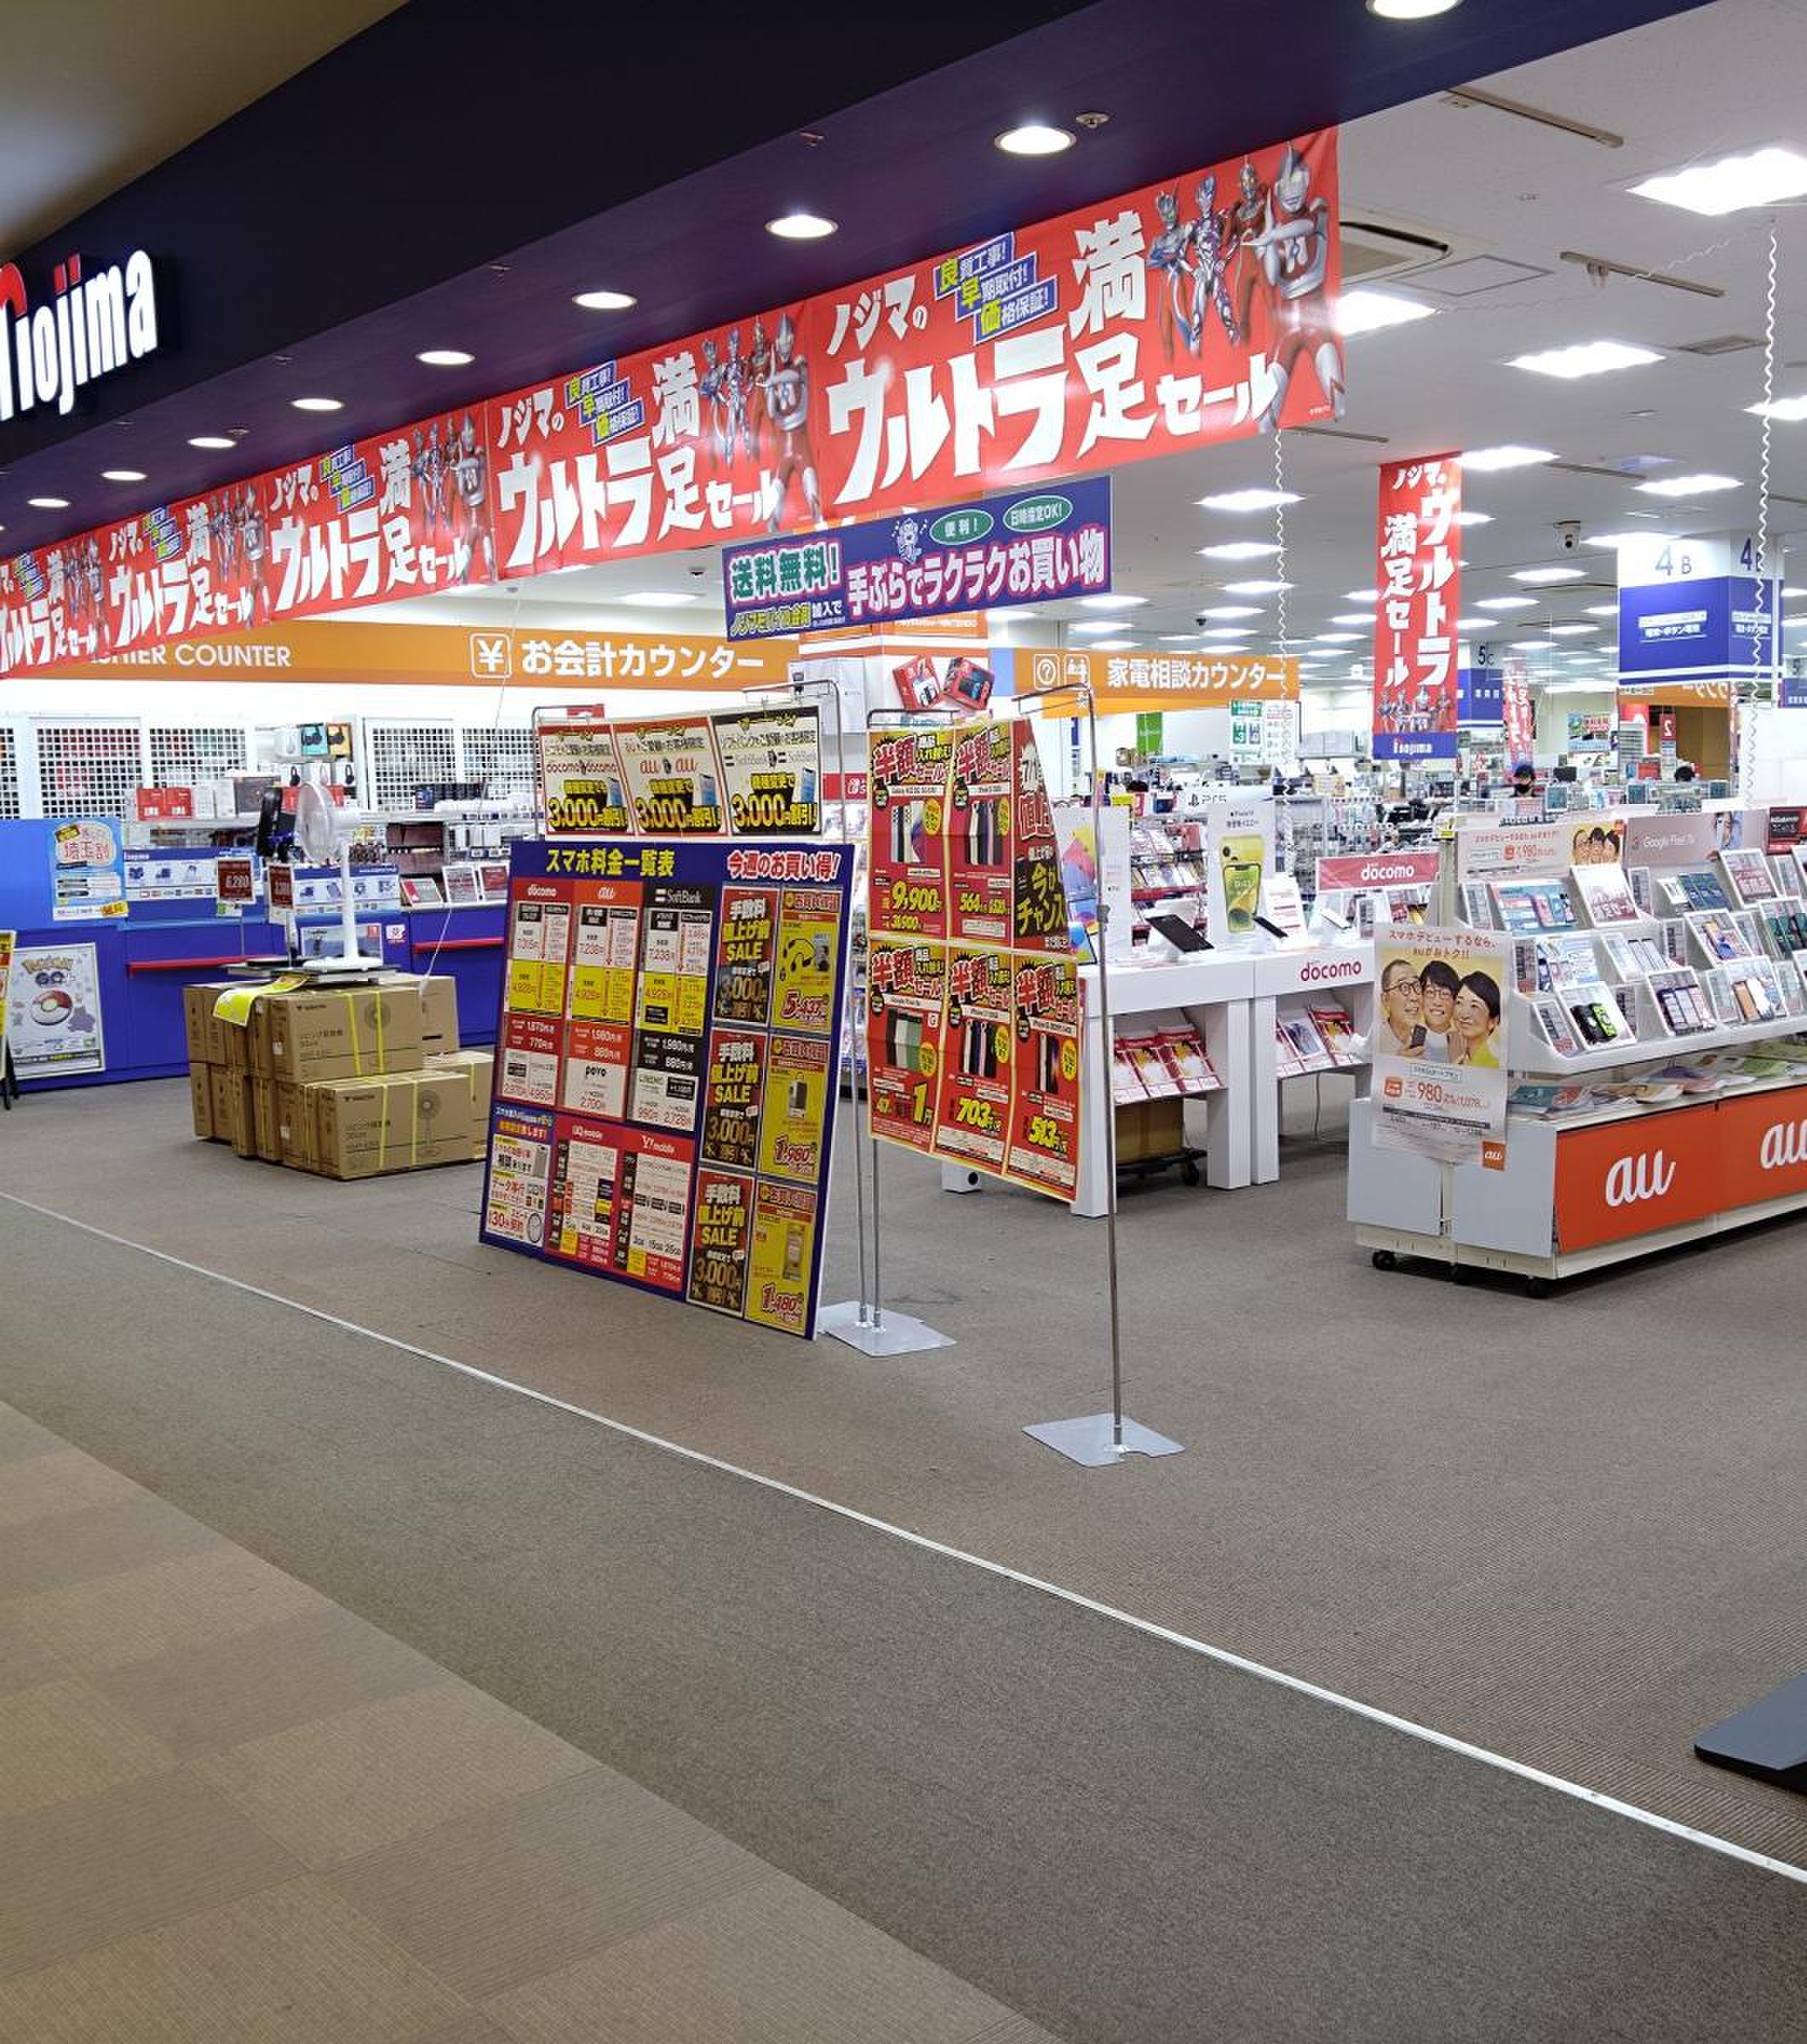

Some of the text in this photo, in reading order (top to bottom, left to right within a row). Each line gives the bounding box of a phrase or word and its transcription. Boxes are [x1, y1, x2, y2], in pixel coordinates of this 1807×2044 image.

[827, 274, 927, 355] ノジマの
[497, 388, 565, 449] ノジマの
[270, 464, 319, 512] ノジマの
[848, 529, 1105, 617] 手ぶらでラクラクお買い物
[1417, 488, 1461, 686] ウルトラ
[175, 644, 291, 667] COUNTER
[521, 640, 763, 678] お会計カウンター
[1107, 657, 1284, 690] 家電相談カウンター
[546, 848, 675, 877] スマホ料金一覧表
[728, 850, 841, 881] 今週のお買い得!
[1361, 863, 1415, 881] docomo
[726, 940, 764, 962] SALE
[1300, 960, 1362, 982] docomo
[714, 1084, 751, 1104] SALE
[1484, 1150, 1503, 1161] au
[1605, 1150, 1677, 1208] au
[702, 1226, 738, 1247] SALE
